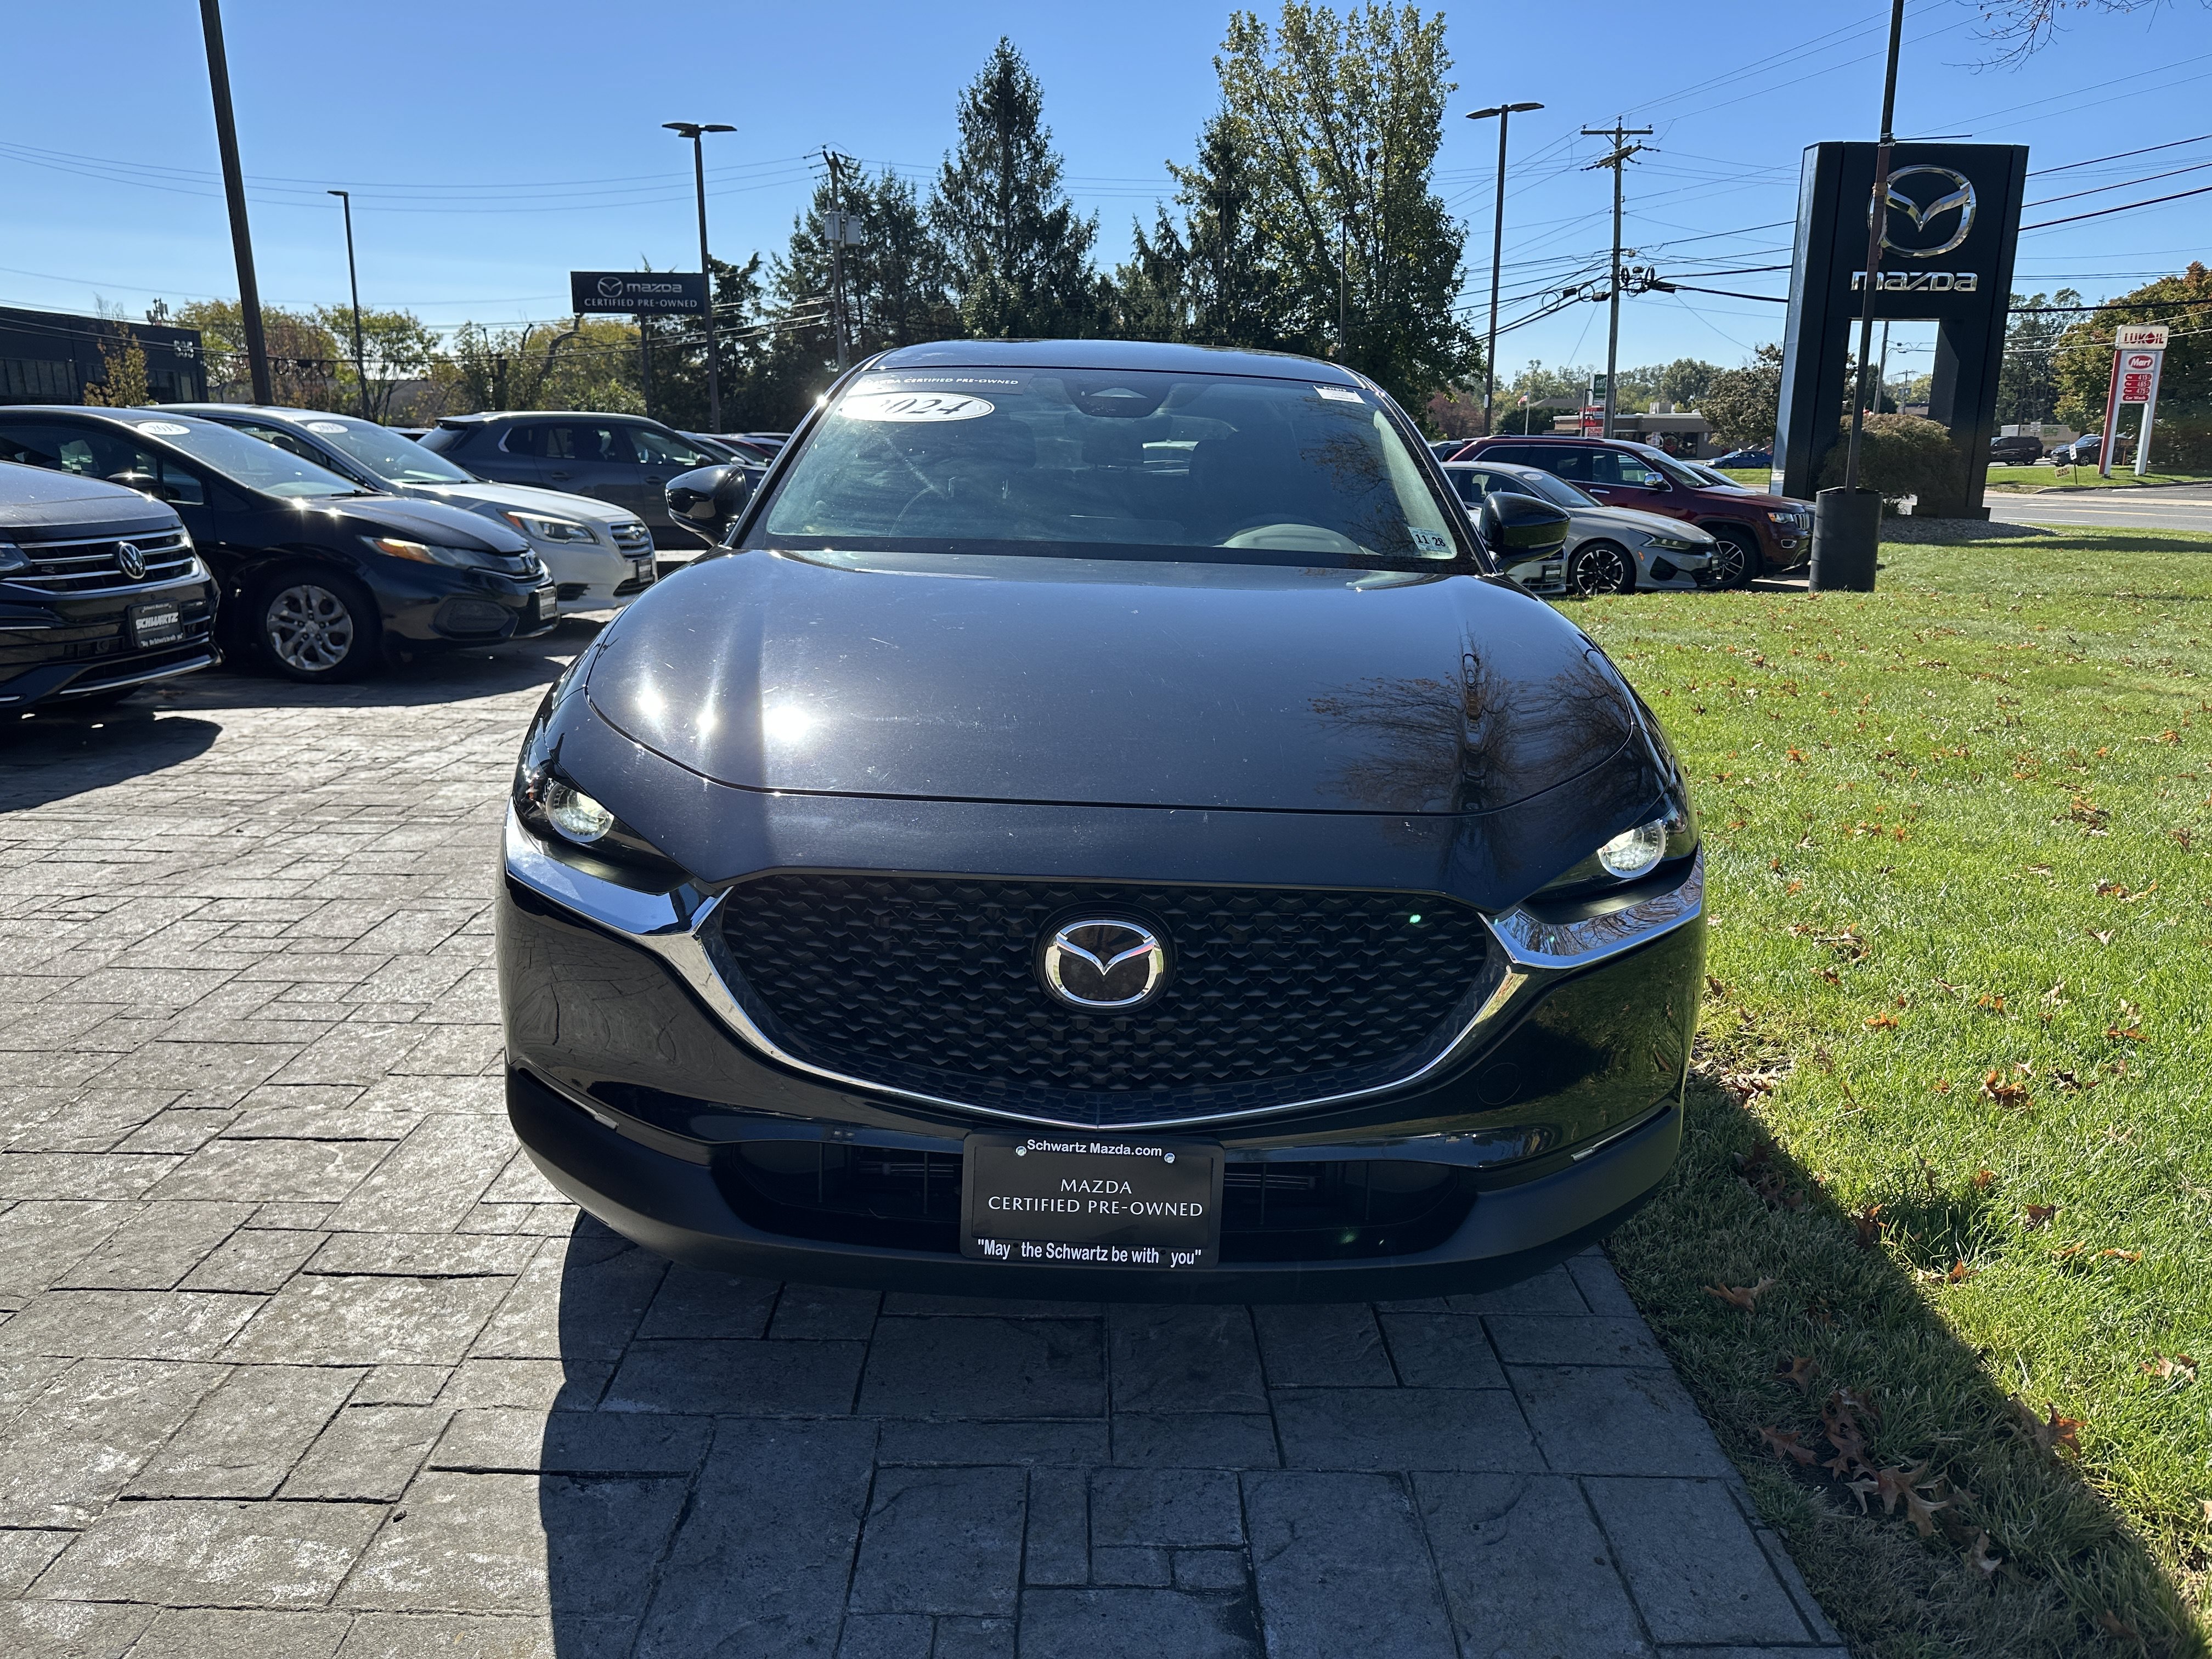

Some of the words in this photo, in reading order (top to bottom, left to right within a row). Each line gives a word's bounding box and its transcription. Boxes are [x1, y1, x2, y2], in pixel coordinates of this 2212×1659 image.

[627, 283, 682, 294] mazda
[584, 297, 634, 307] CERTIFIED
[637, 298, 697, 308] PRE-OWNED
[2124, 331, 2164, 344] LUKOIL
[2130, 358, 2151, 367] Mart
[1415, 534, 1430, 544] 11
[1432, 537, 1446, 547] 28
[136, 612, 179, 630] SCHWARTZ
[1027, 1139, 1087, 1153] Schwartz
[1090, 1142, 1163, 1156] Mazda.com
[1060, 1179, 1132, 1194] MAZDA
[988, 1196, 1080, 1212] CERTIFIED
[1088, 1201, 1203, 1217] PRE-OWNED
[978, 1239, 1011, 1260] "May
[1021, 1242, 1042, 1258] the
[1046, 1242, 1108, 1261] Schwartz
[1111, 1246, 1128, 1262] be
[1131, 1247, 1159, 1263] with
[1170, 1249, 1201, 1268] you"
